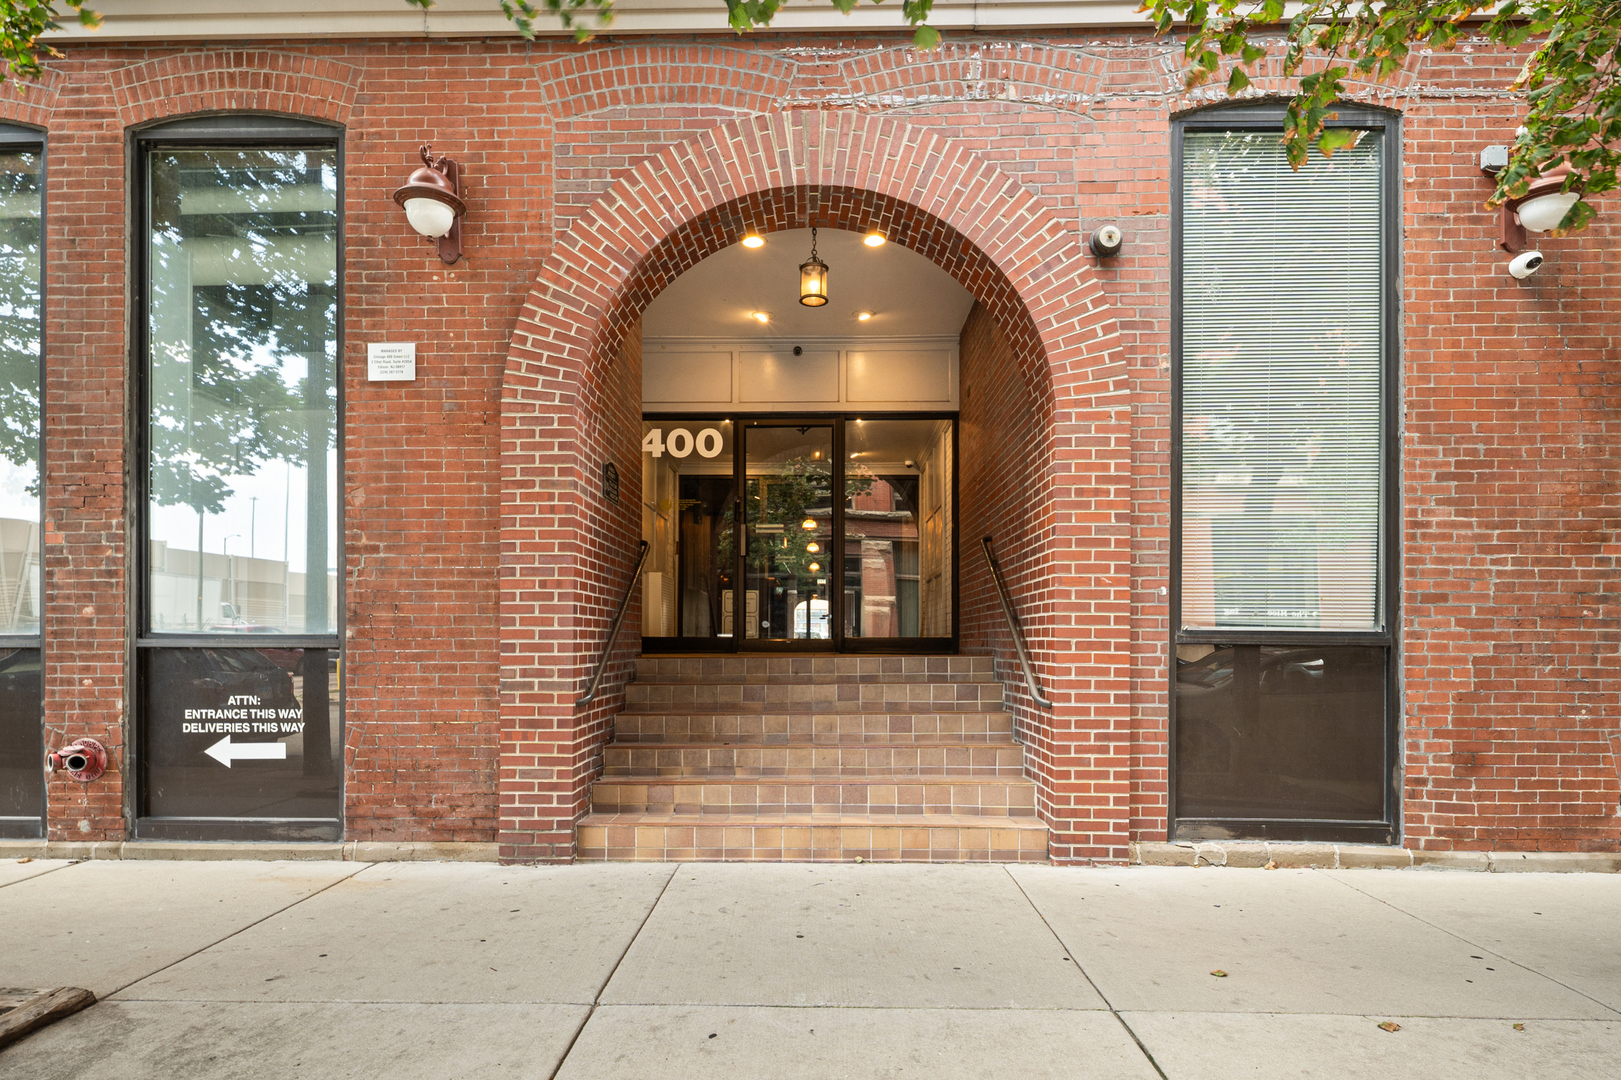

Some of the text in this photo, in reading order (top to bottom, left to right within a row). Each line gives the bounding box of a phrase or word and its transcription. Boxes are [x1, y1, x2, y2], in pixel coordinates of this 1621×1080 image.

[642, 428, 723, 458] 400
[227, 695, 261, 706] ATTN:
[184, 709, 303, 719] ENTRANCE THIS WAY
[182, 722, 306, 733] DELIVERIES THIS WAY
